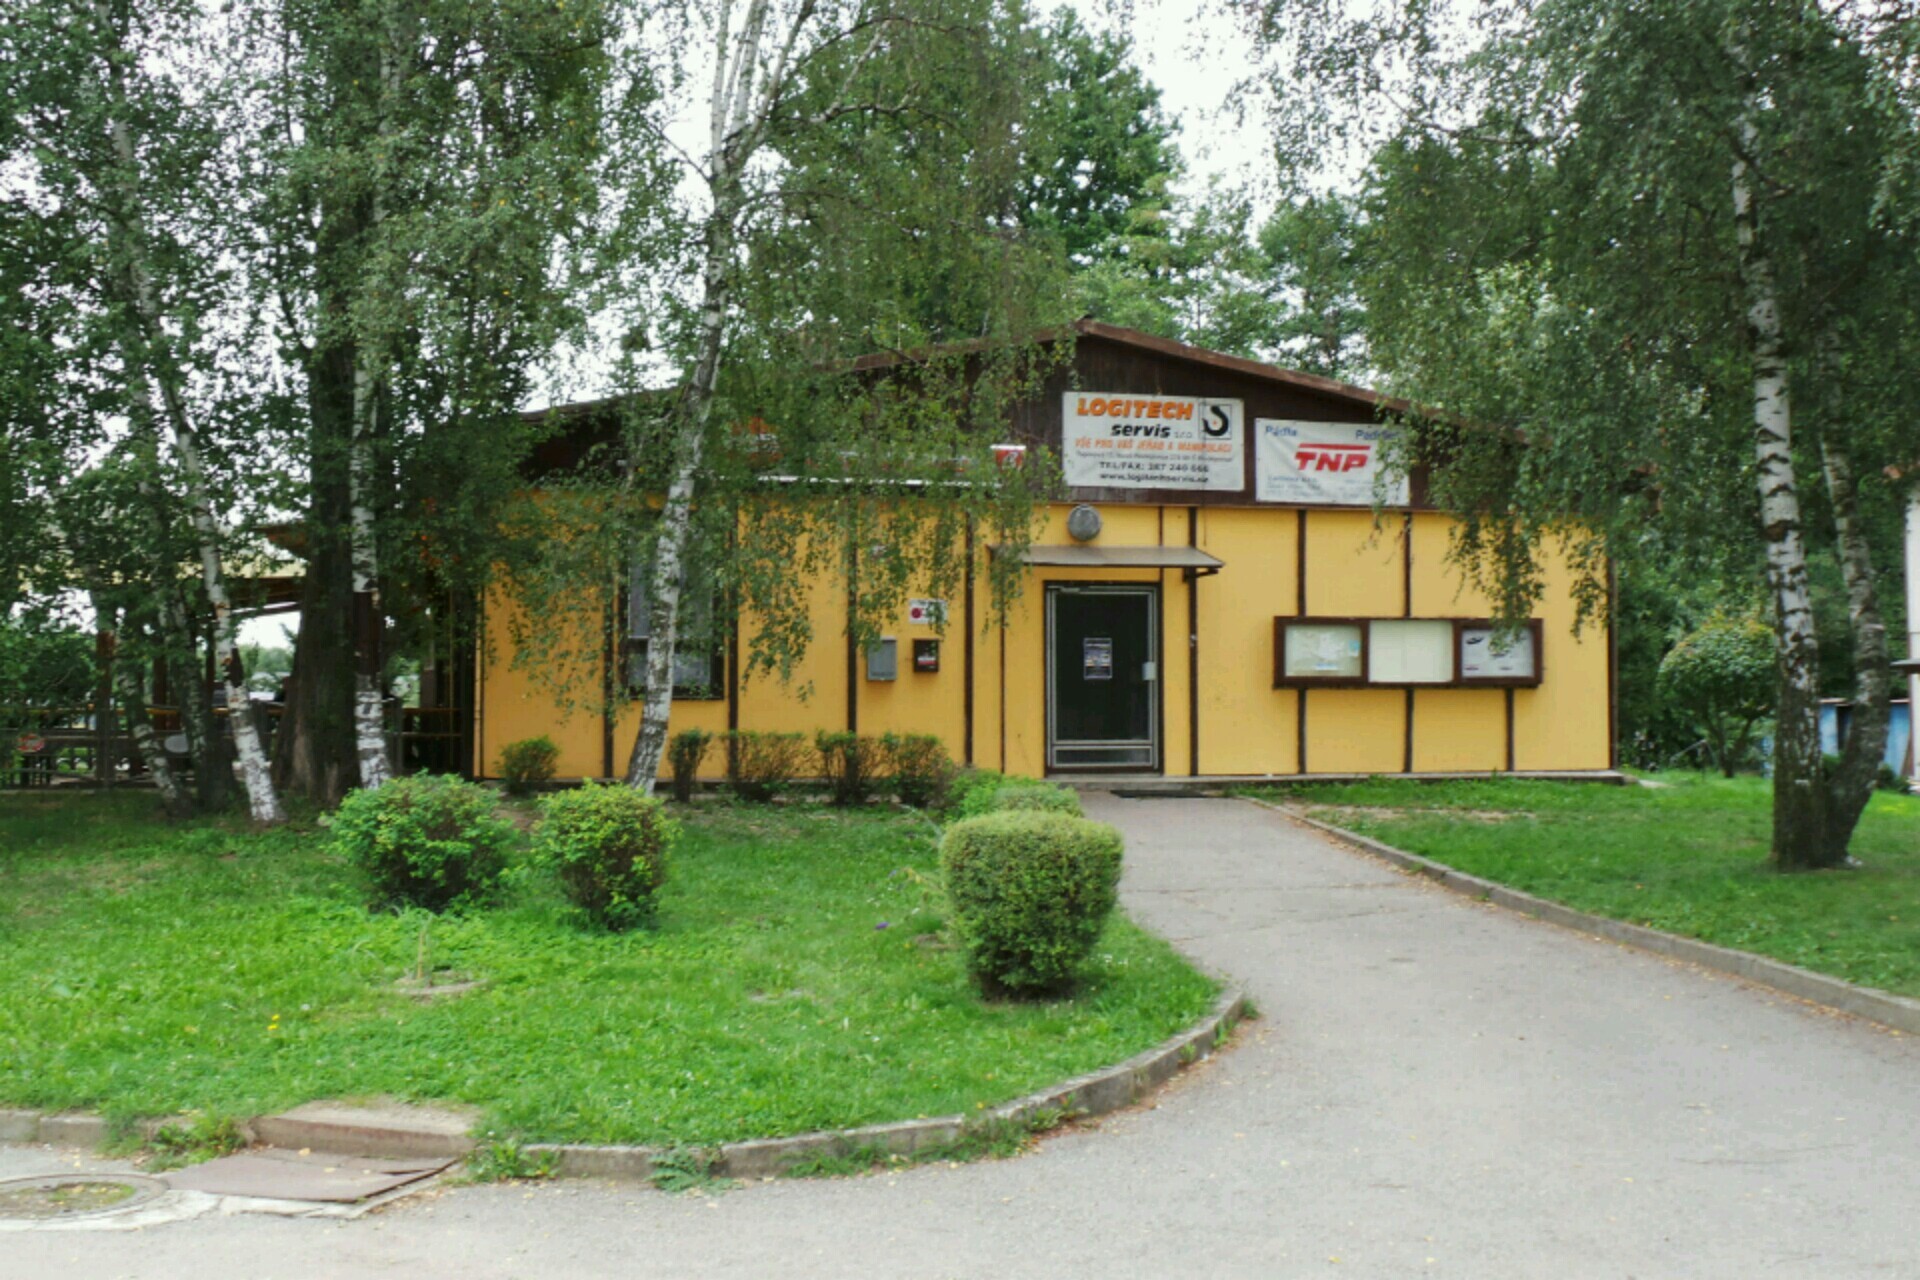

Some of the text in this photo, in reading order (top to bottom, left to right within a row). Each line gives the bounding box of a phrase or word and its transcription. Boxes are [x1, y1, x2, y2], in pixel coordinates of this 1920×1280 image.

[1077, 397, 1193, 420] LOGITECH
[1111, 424, 1171, 438] servis
[1094, 438, 1113, 449] PRO
[1295, 452, 1368, 472] TNP
